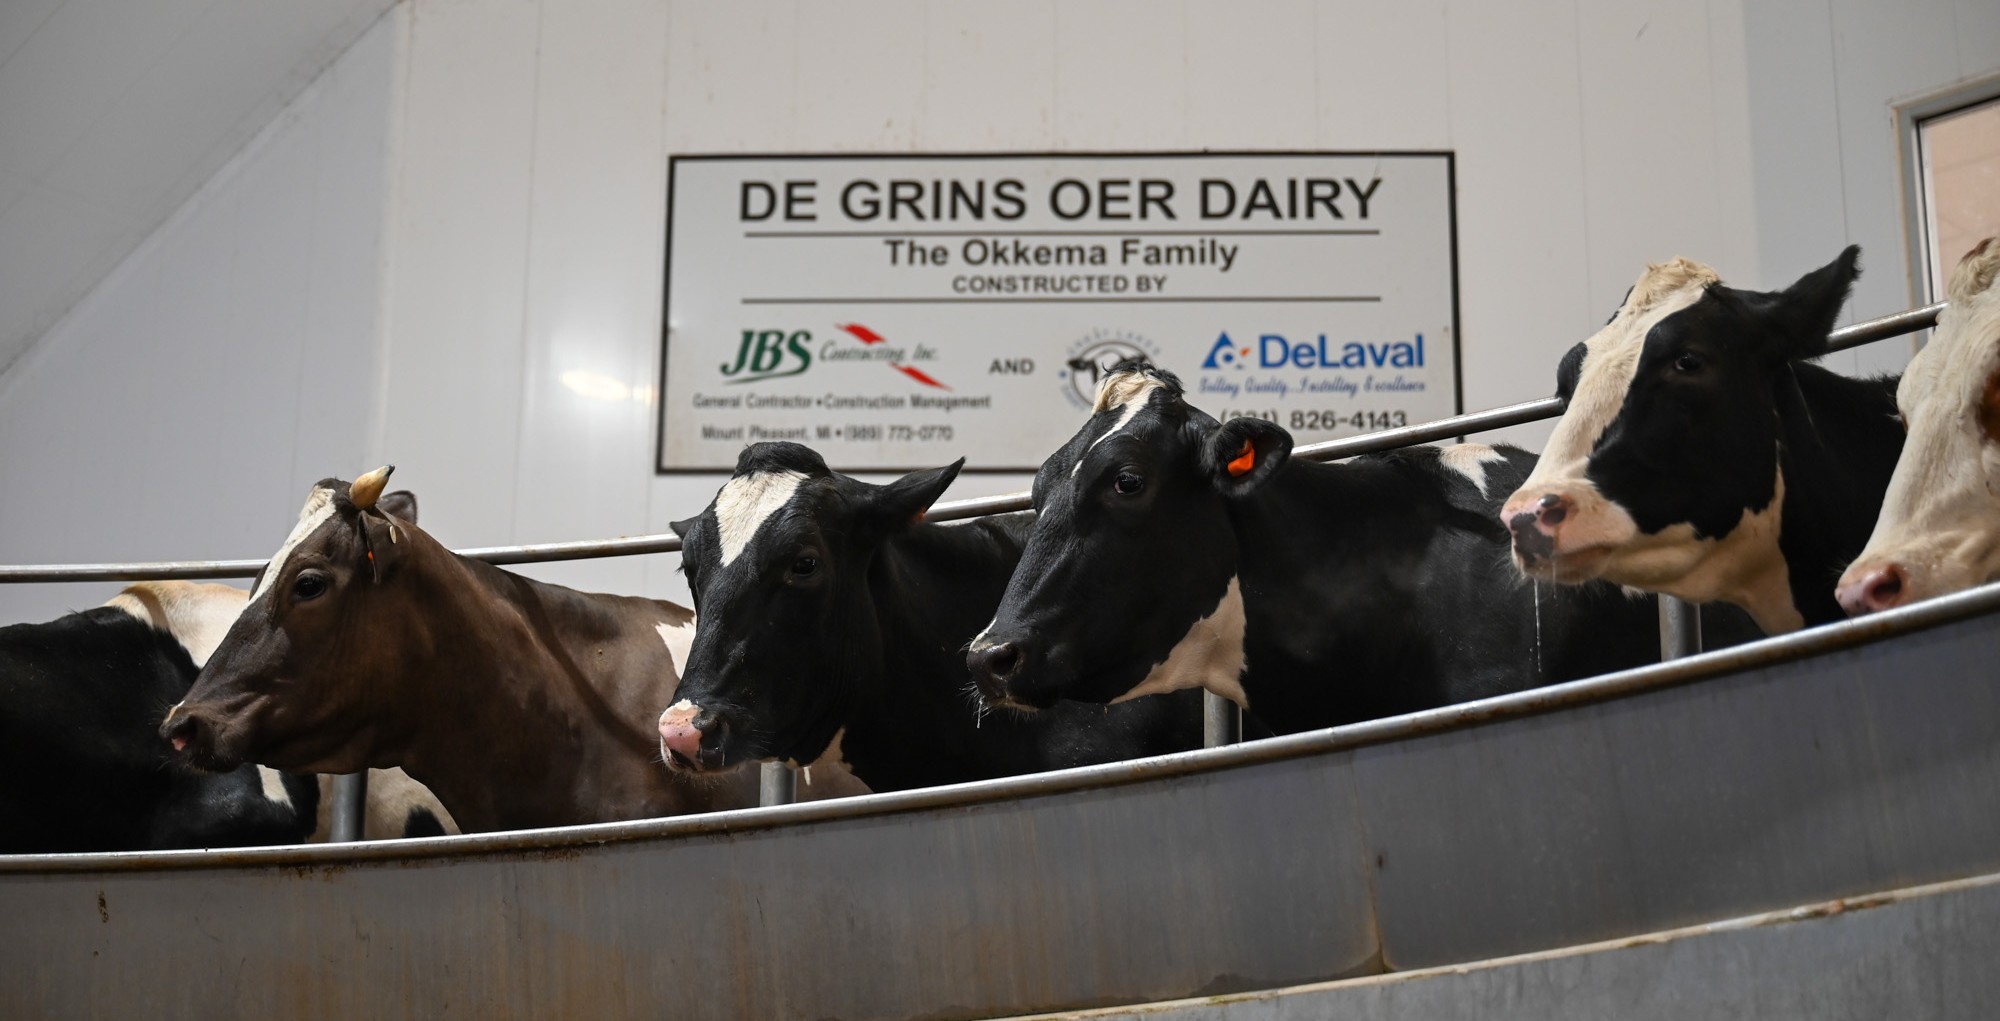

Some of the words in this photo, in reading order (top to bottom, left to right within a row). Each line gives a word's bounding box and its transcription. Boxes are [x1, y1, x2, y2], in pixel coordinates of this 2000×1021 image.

[740, 180, 817, 222] DE
[840, 179, 1027, 222] GRINS
[1049, 178, 1177, 221] OER
[1200, 178, 1382, 220] DAIRY
[884, 239, 949, 266] The
[962, 238, 1107, 266] Okkema
[1121, 238, 1238, 272] Family
[952, 275, 1129, 293] CONSTRUCTED
[1136, 275, 1167, 293] BY
[719, 327, 814, 378] JBS
[1259, 333, 1424, 369] DeLaval
[989, 358, 1035, 375] AND
[693, 394, 741, 408] General
[910, 394, 991, 412] Management
[1290, 409, 1407, 431] 826-4143
[702, 426, 743, 440] Mount
